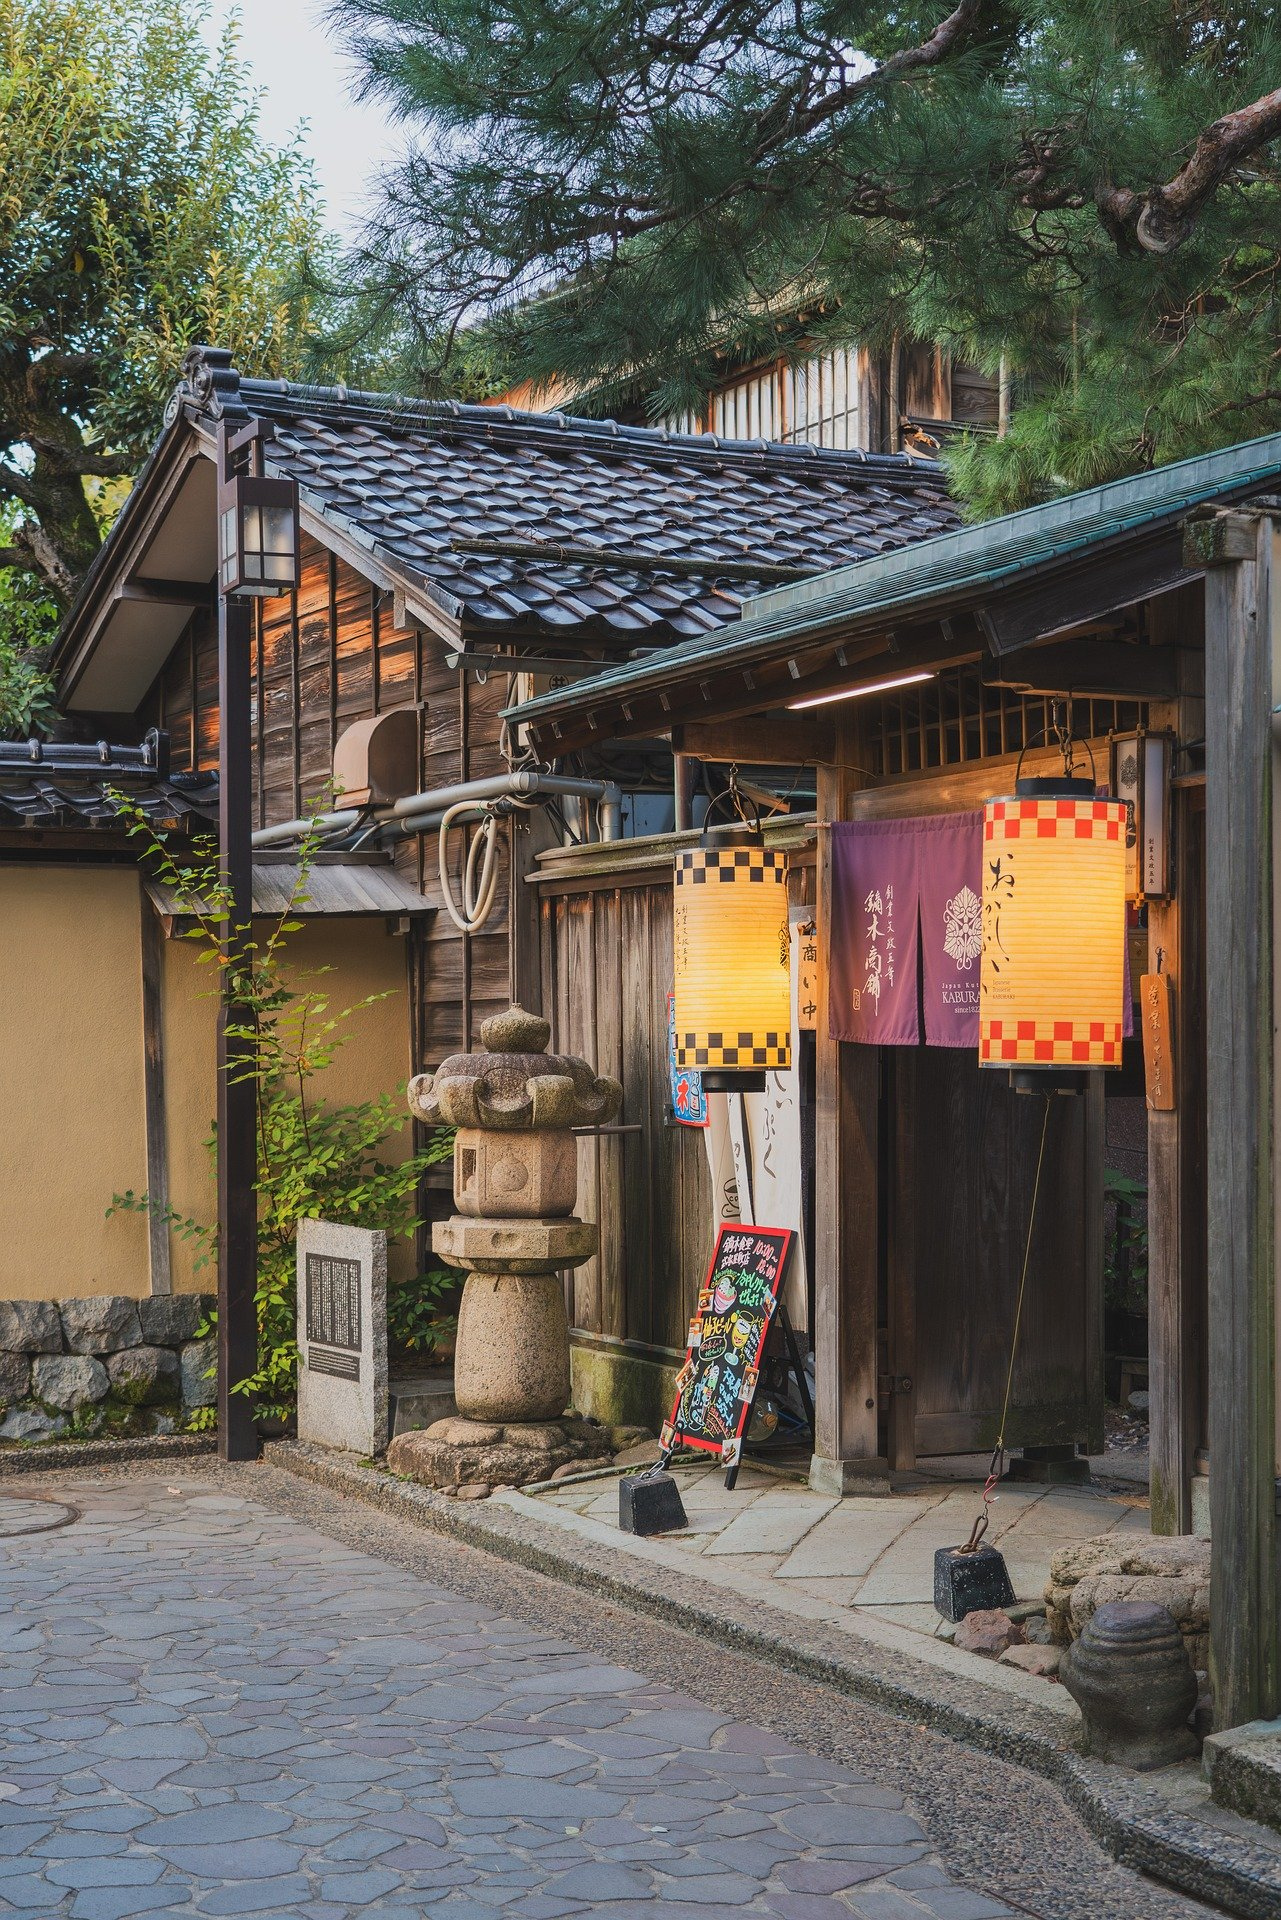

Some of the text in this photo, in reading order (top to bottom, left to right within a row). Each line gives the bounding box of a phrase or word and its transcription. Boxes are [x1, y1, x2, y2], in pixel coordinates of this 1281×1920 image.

[802, 943, 817, 1021] 商い中
[1148, 984, 1162, 1097] 営業しています
